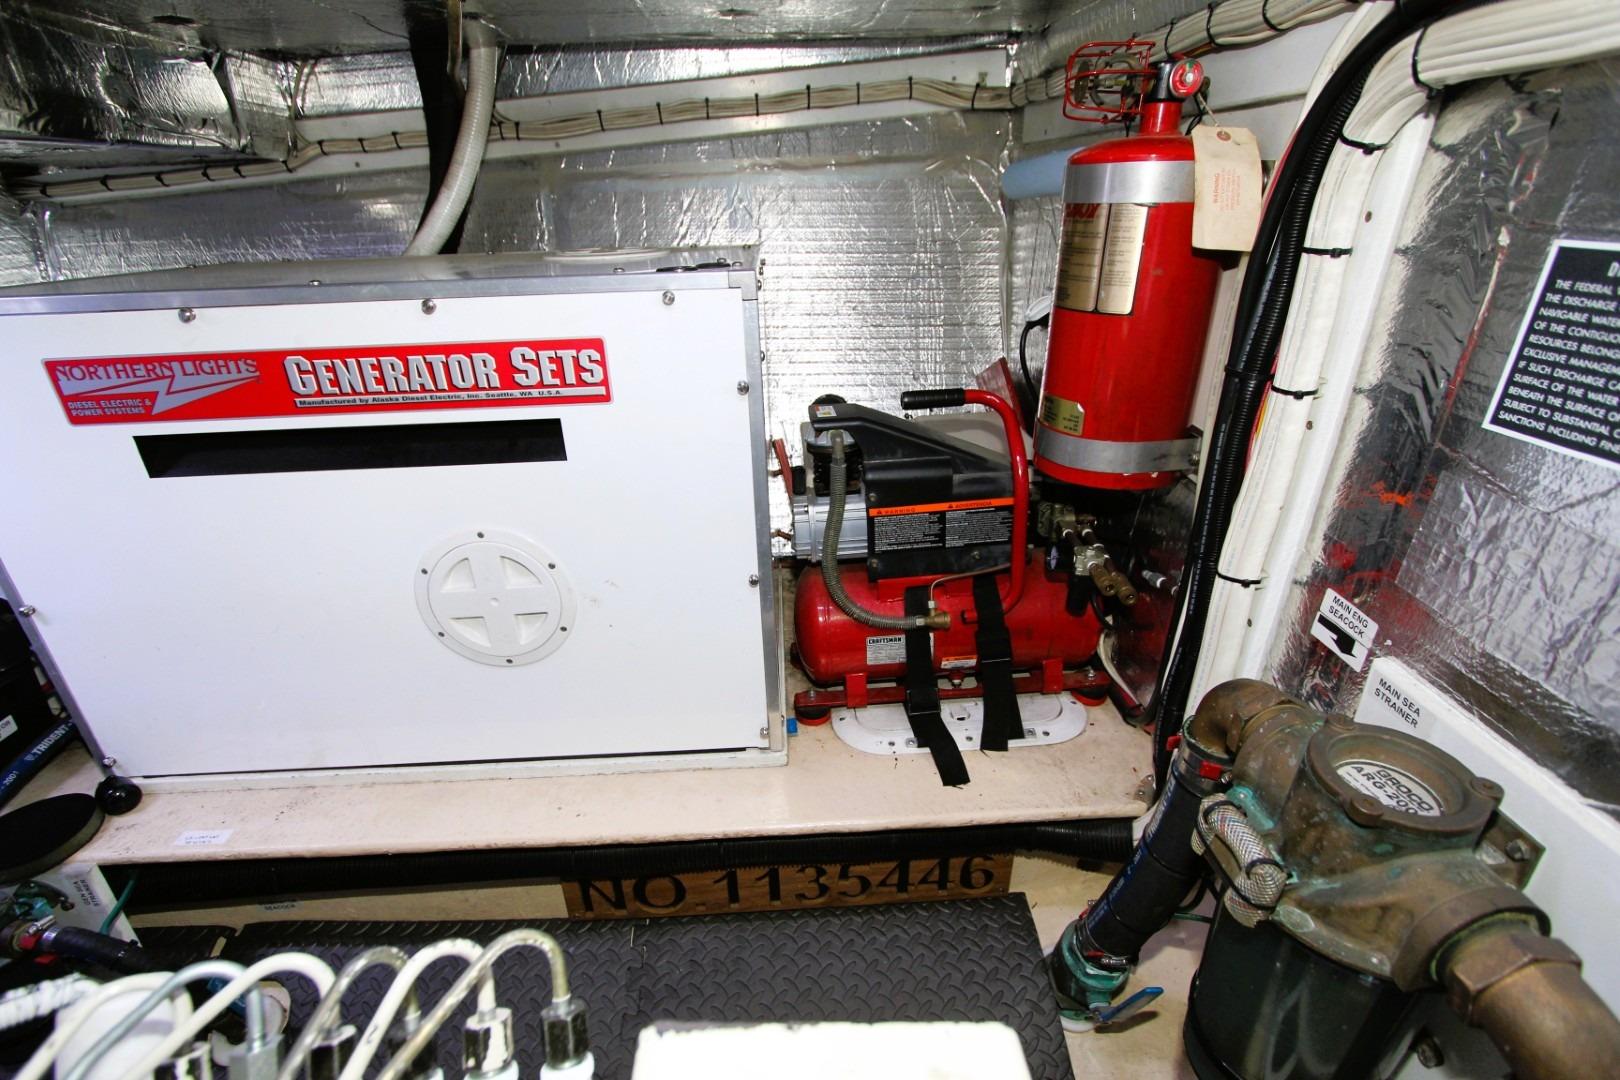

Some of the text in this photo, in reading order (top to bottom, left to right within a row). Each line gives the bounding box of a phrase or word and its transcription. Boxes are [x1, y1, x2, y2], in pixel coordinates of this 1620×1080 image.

[1555, 279, 1573, 291] THE
[1574, 281, 1613, 296] FEDERAL
[1538, 306, 1589, 323] NAVIGABLE
[1545, 292, 1618, 312] THE DISCHARGE
[1533, 320, 1548, 331] OF
[1549, 322, 1567, 335] THE
[1523, 347, 1568, 364] EXCLUSIVE
[1528, 333, 1578, 351] RESOURCES
[56, 358, 261, 383] NORTHERN LIGHTS
[283, 346, 604, 396] GENERATOR SETS
[1518, 360, 1528, 369] IF
[1527, 362, 1552, 374] SUCH
[1553, 368, 1607, 388] DISCHARGE
[299, 397, 357, 406] Manufactured
[359, 397, 369, 405] by
[372, 395, 399, 403] Alaska
[402, 394, 427, 402] Diesel
[1507, 385, 1545, 402] BENEATH
[1546, 395, 1564, 408] THE
[1564, 401, 1607, 419] SURFACE
[1512, 373, 1619, 406] SURFACE OF THE WATER
[68, 398, 152, 410] DIESEL ELECTRIC &
[71, 407, 145, 417] POWER SYSTEMS
[1503, 398, 1537, 414] SUBJECT
[1538, 408, 1551, 418] TO
[1552, 412, 1610, 436] SUBSTANTIAL
[1498, 411, 1546, 431] SANCTIONS
[1547, 425, 1597, 447] INCLUDING
[1328, 605, 1365, 639] SEACOCK
[1332, 595, 1369, 629] MAIN ENG
[868, 637, 902, 645] CRAFTSMAN
[1374, 688, 1419, 728] STRAINER
[1379, 678, 1421, 717] MAIN SEA
[31, 724, 69, 756] TRIDENT
[1376, 769, 1434, 811] GROCO
